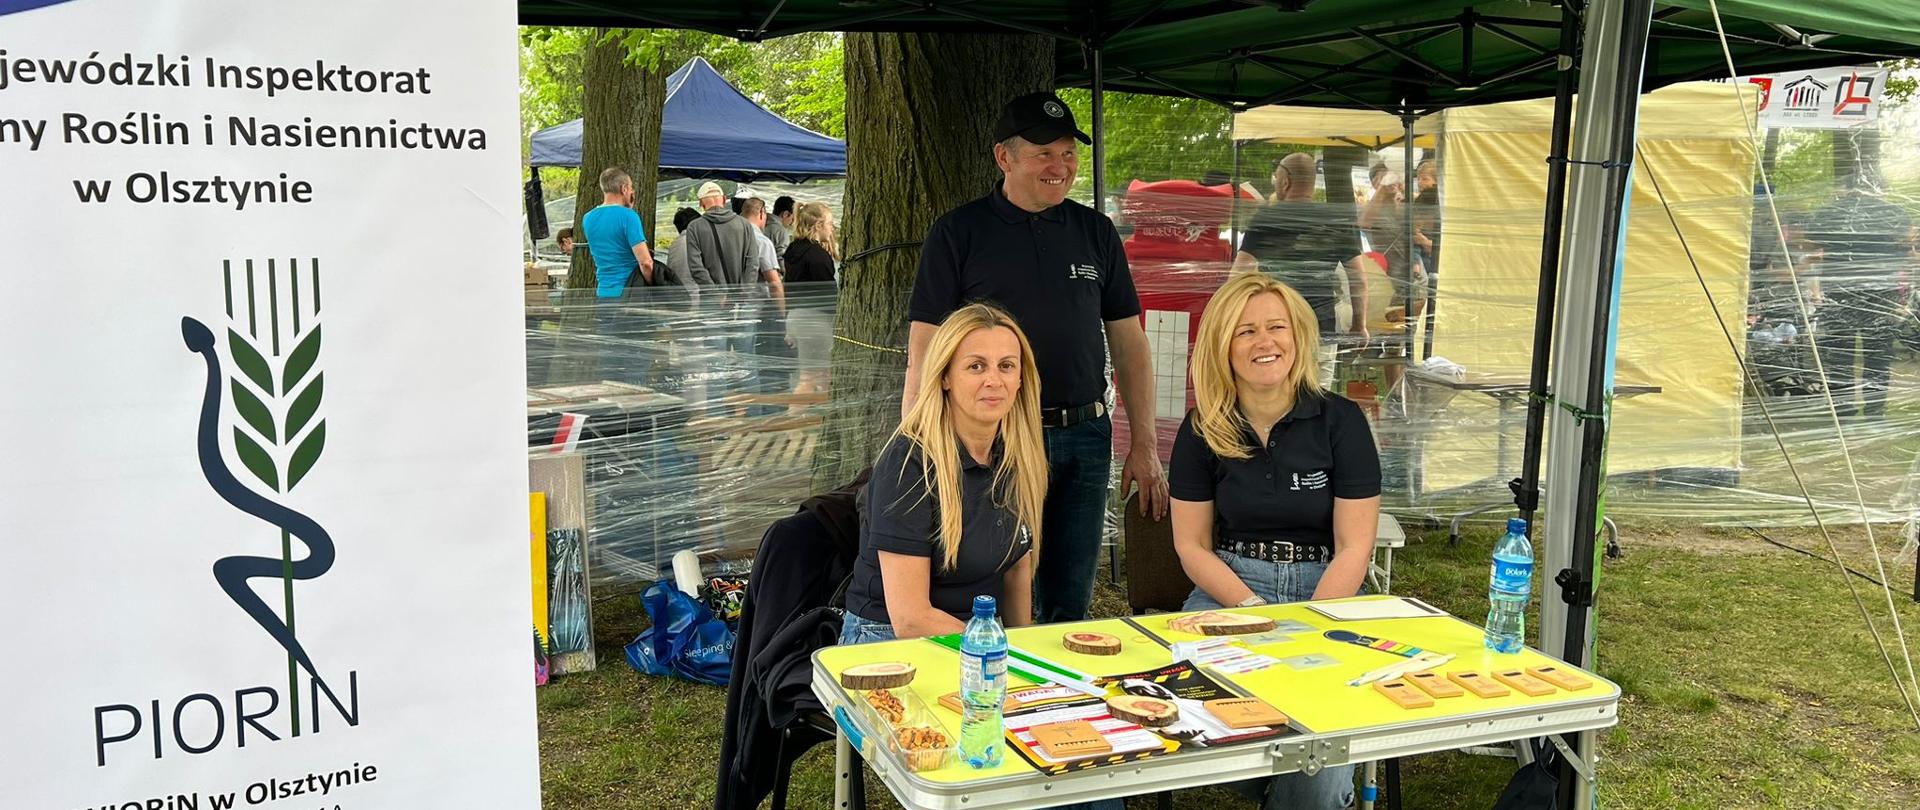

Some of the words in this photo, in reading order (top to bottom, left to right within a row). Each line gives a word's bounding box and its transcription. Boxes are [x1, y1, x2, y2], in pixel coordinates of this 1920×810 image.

[206, 57, 431, 97] Inspektorat
[62, 112, 189, 145] Roślin
[204, 114, 213, 146] i
[228, 116, 487, 150] Nasiennictwa
[73, 180, 112, 203] w
[126, 171, 313, 211] Olsztynie
[208, 792, 236, 810] w
[245, 763, 378, 805] Olsztynie
